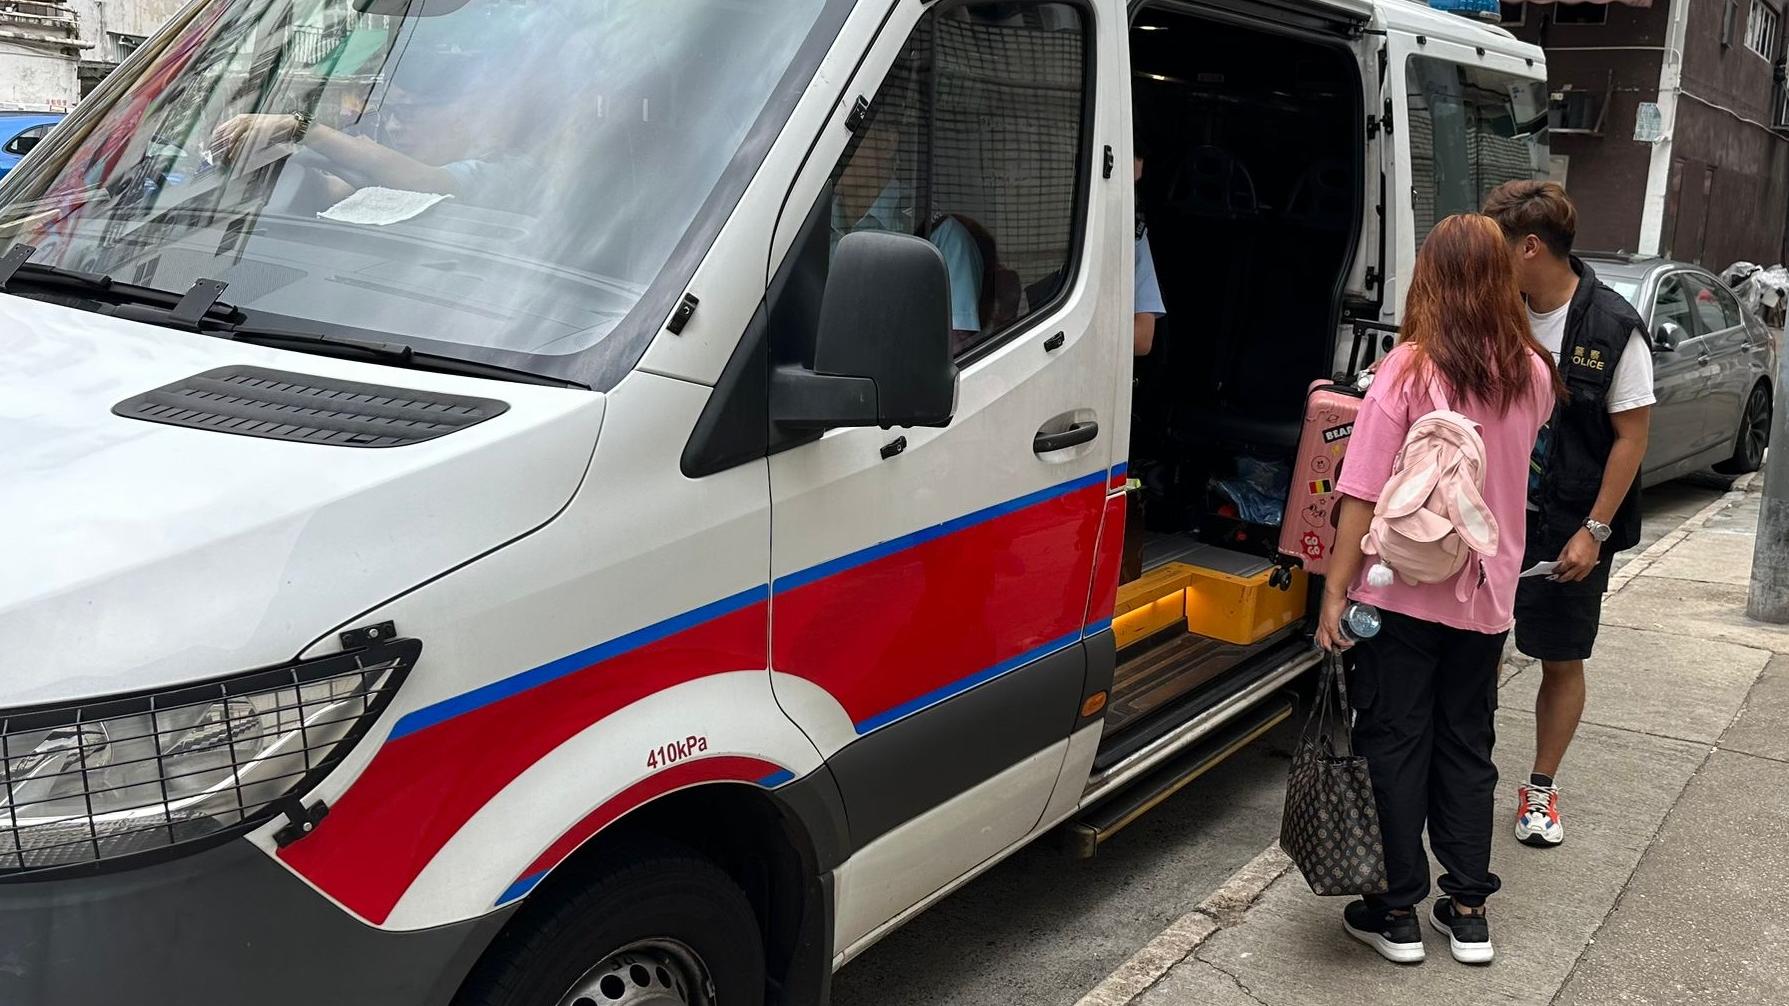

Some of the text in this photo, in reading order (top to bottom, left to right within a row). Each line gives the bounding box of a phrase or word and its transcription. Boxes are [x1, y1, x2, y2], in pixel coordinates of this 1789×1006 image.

[1571, 355, 1605, 370] OLICE
[1304, 536, 1318, 545] GO
[1307, 546, 1320, 555] GO
[647, 735, 708, 769] 410kPa
